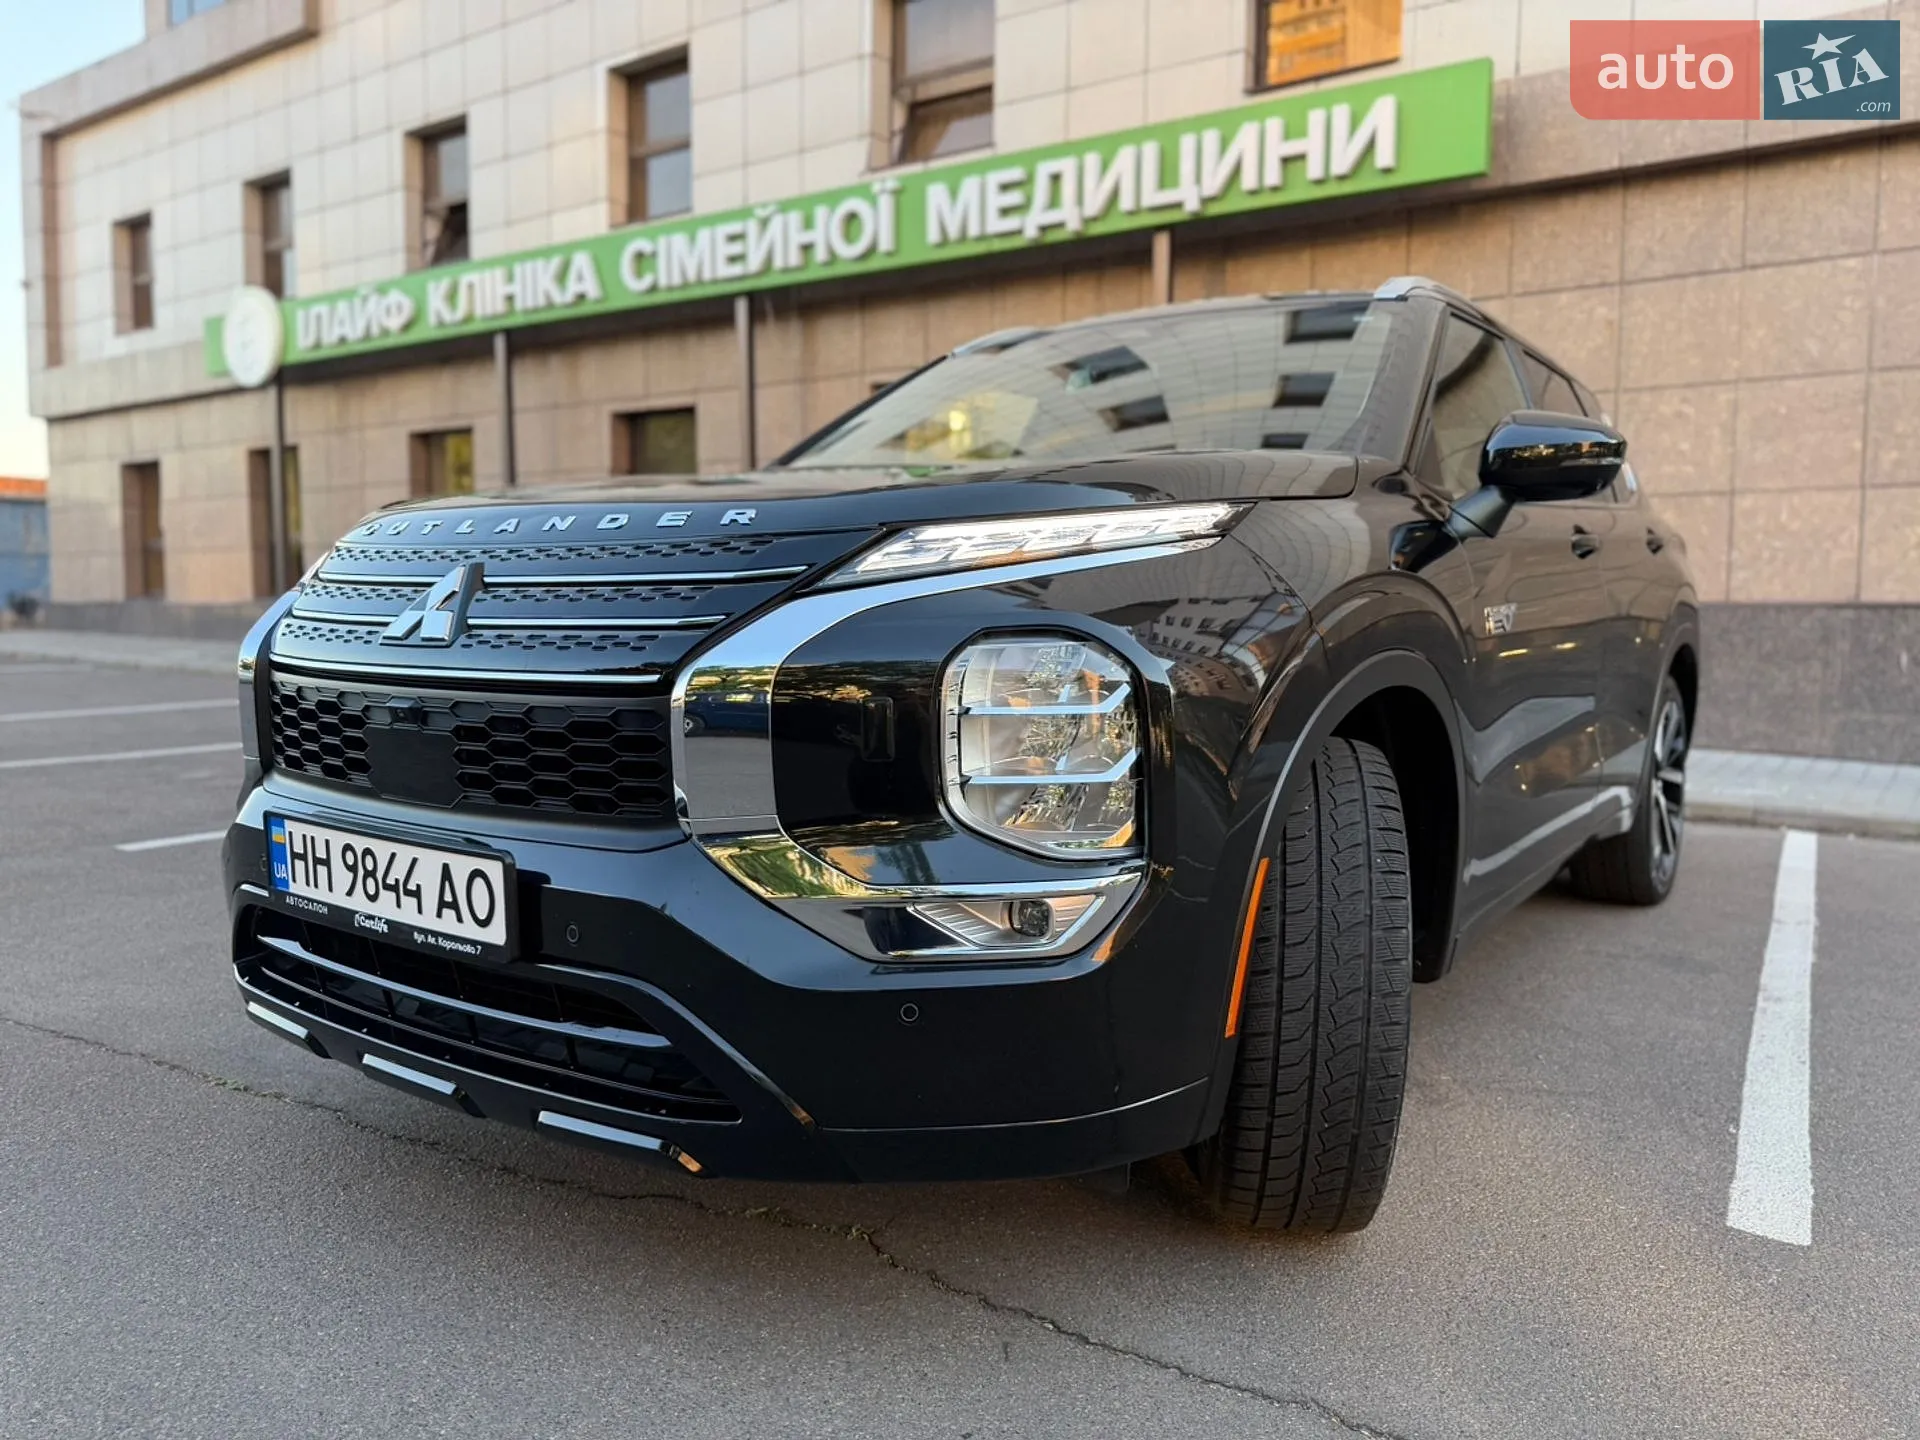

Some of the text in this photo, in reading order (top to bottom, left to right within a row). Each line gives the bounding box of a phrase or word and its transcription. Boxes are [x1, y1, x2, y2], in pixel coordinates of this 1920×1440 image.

[426, 250, 604, 327] КЛІНІКА
[620, 178, 900, 293] СІМЕЙНОЇ
[925, 94, 1398, 247] МЕДИЦИНИ
[361, 508, 757, 537] OUTLANDER
[273, 861, 288, 880] UA
[288, 830, 495, 928] HH 9844 AO
[286, 895, 328, 915] АВТОСАЛОН
